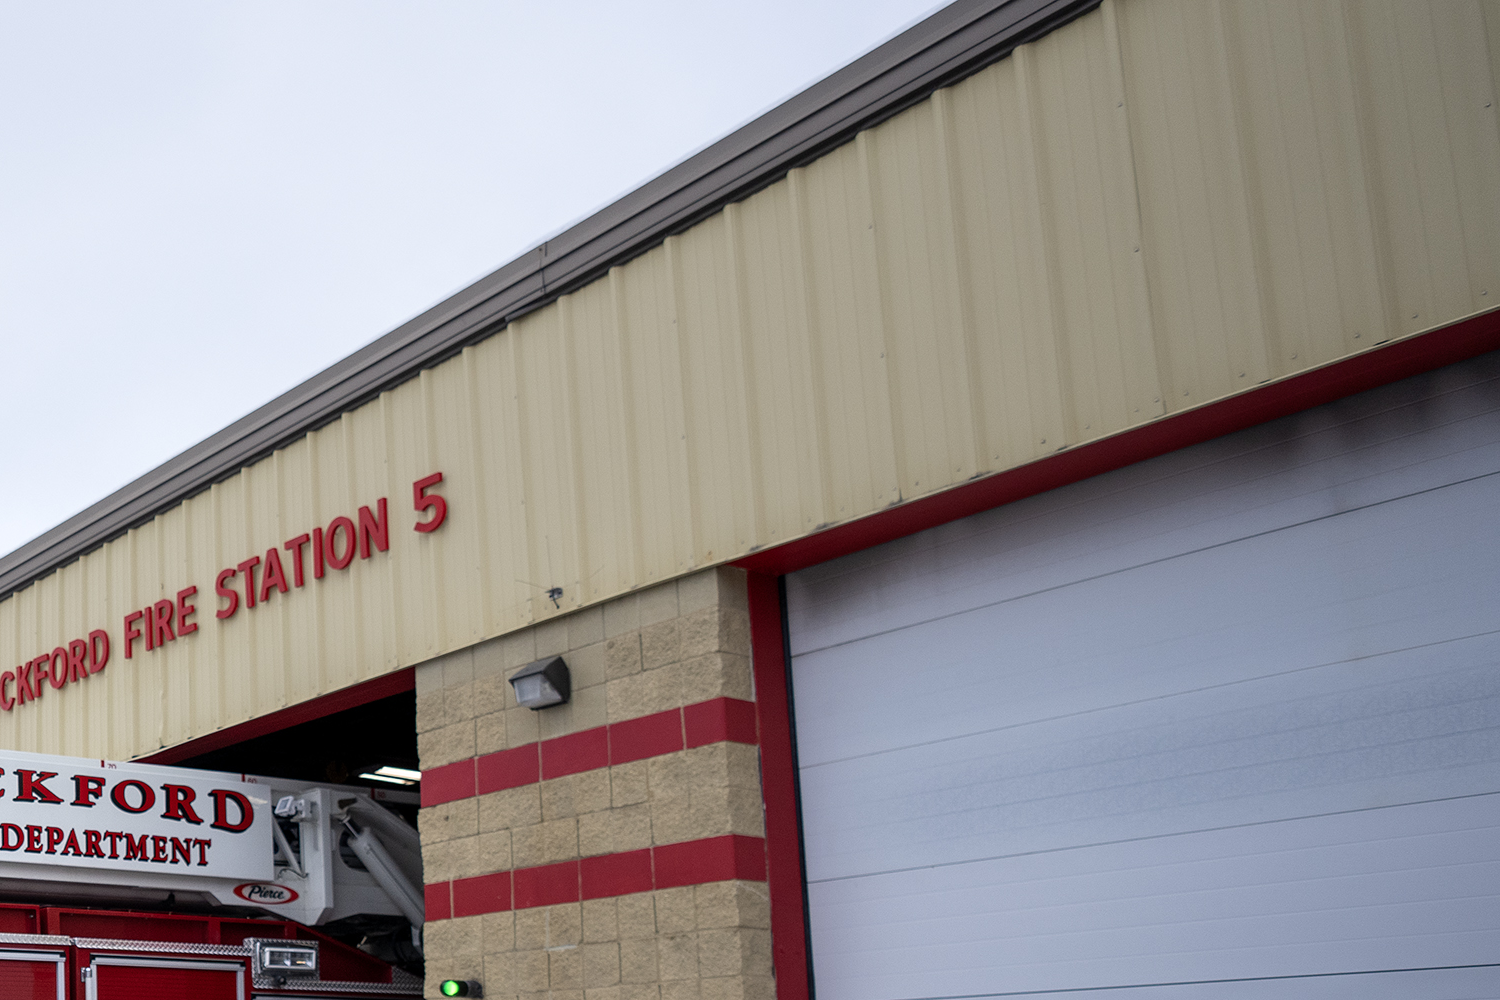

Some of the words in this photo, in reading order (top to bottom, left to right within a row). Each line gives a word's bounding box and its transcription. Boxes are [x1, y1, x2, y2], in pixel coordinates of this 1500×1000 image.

[123, 585, 198, 659] FIRE
[215, 497, 389, 619] STATION
[412, 472, 447, 533] 5
[248, 885, 285, 900] Pierce
